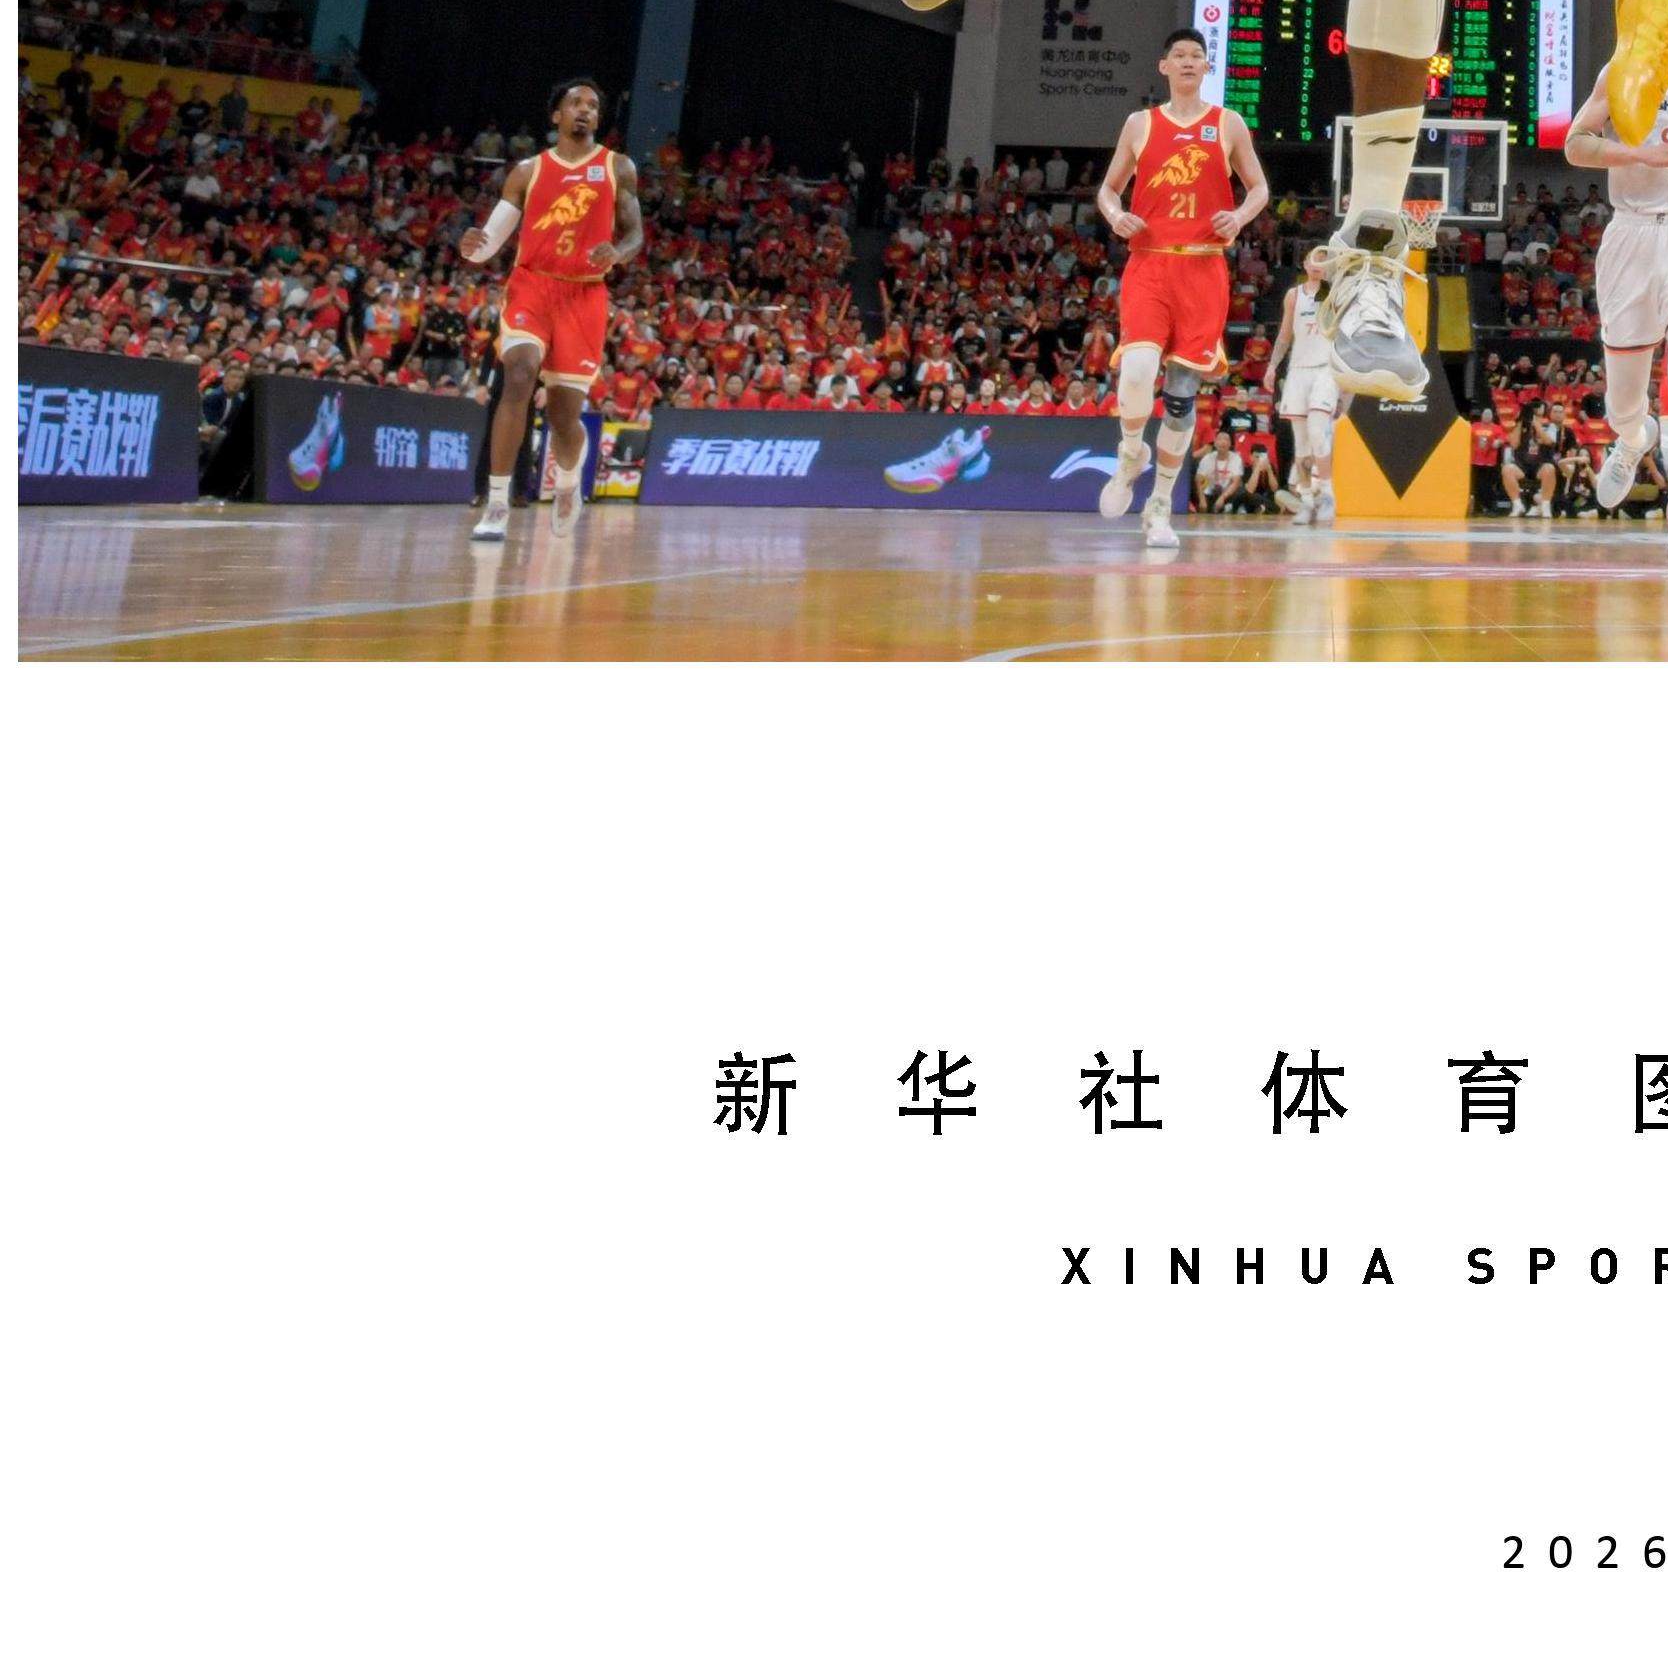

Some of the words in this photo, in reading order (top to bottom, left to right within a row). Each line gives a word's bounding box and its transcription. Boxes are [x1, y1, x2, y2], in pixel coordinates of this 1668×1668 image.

[1040, 83, 1081, 97] Sports
[1083, 83, 1128, 97] Centre
[1170, 193, 1196, 219] 21
[556, 230, 576, 257] 5
